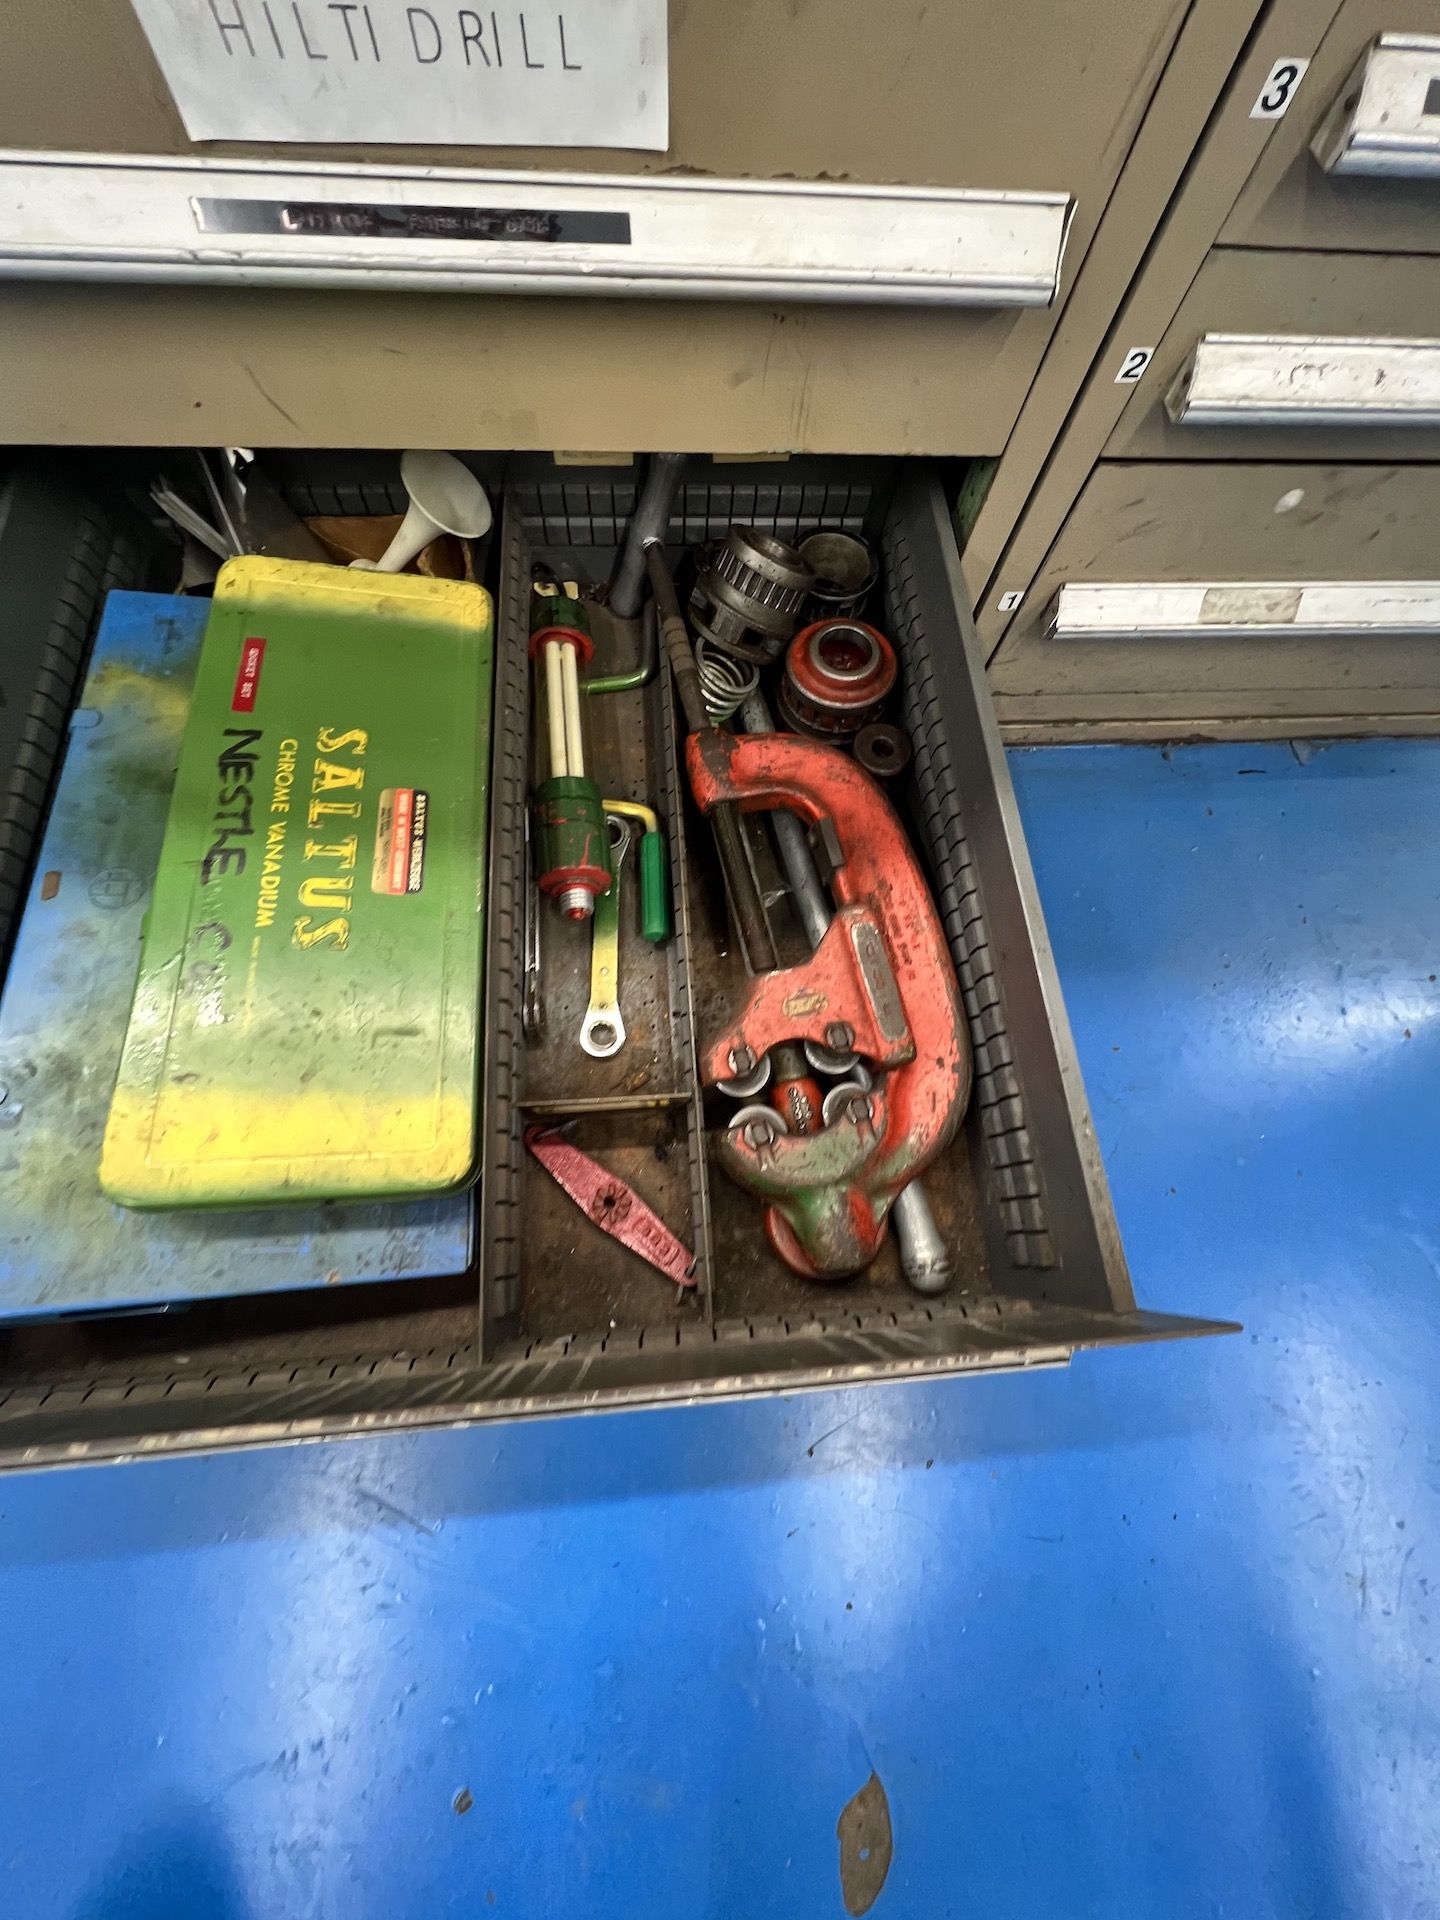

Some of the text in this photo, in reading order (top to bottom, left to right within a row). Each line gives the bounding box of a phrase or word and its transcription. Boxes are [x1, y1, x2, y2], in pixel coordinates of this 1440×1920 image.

[208, 0, 582, 70] HILTI DRILL
[1261, 65, 1299, 112] 3
[1121, 352, 1148, 379] 2
[1007, 593, 1018, 609] 1
[201, 727, 265, 886] NESTLE
[255, 737, 299, 929] CHROME VANADIUM
[291, 725, 370, 952] SALTUS
